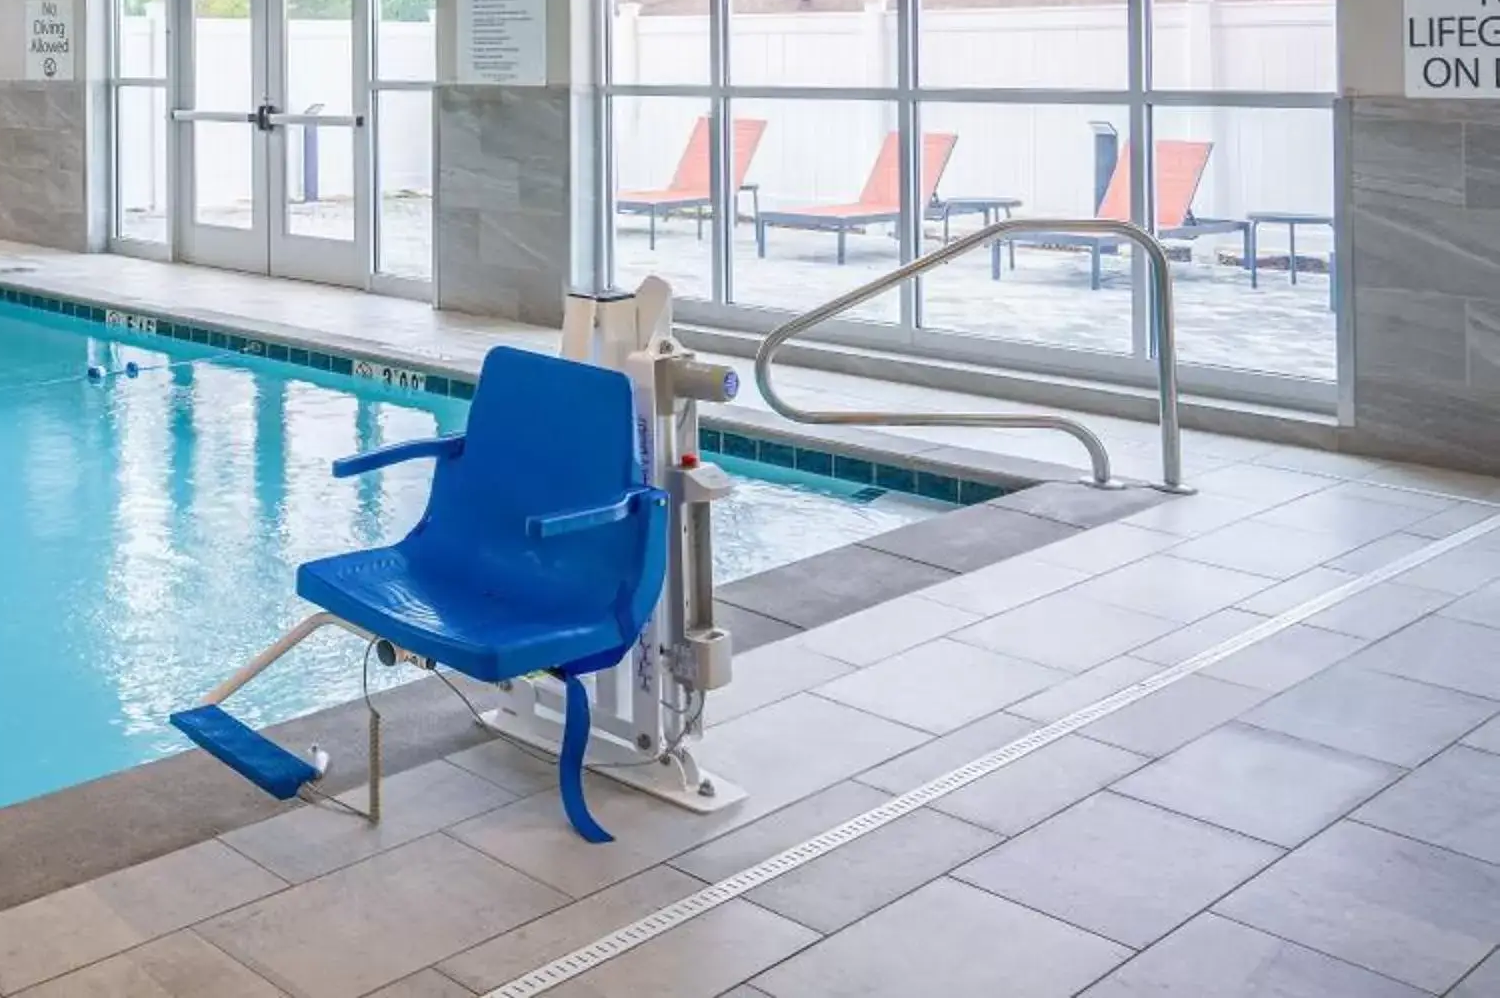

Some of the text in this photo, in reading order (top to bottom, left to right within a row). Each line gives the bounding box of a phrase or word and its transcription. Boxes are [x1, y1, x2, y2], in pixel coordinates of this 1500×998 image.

[42, 1, 57, 16] No
[33, 20, 65, 39] Diving
[29, 38, 69, 53] Allowed
[1422, 57, 1479, 88] ON
